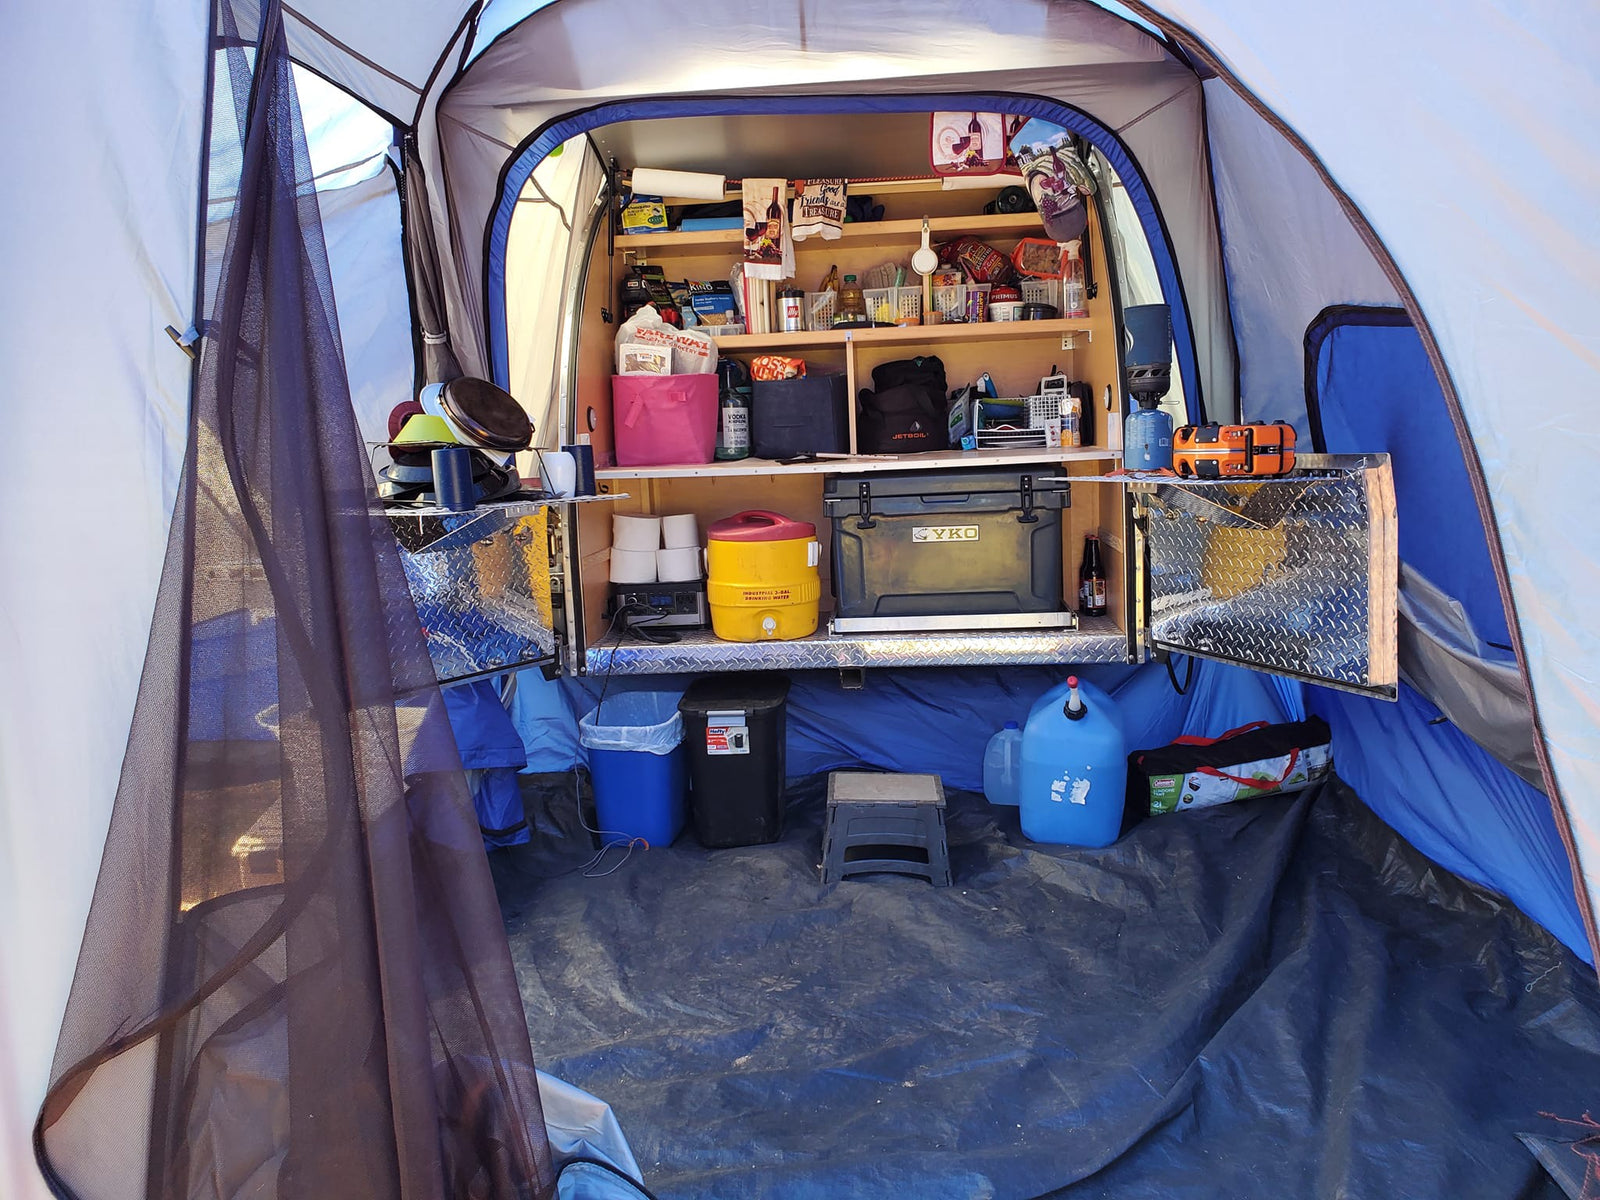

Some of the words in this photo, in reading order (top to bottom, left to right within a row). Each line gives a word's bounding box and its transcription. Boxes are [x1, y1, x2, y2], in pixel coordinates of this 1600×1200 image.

[820, 184, 840, 196] Good
[800, 193, 829, 209] Friends
[804, 206, 840, 218] TREASURE
[892, 432, 927, 440] JETBOIL
[932, 527, 978, 540] YKO
